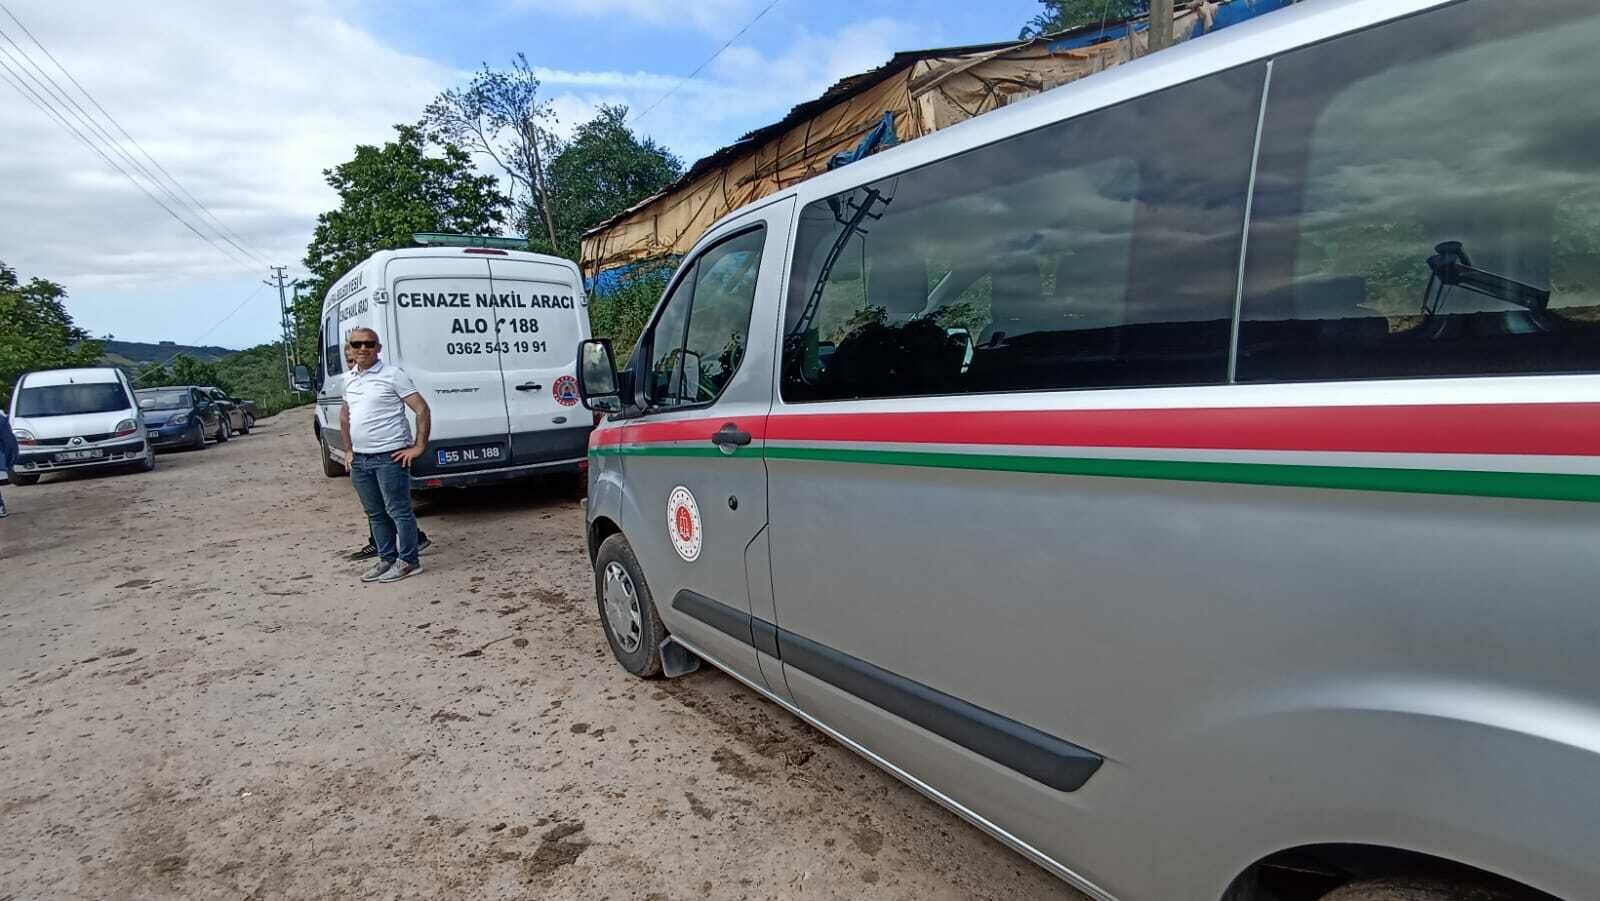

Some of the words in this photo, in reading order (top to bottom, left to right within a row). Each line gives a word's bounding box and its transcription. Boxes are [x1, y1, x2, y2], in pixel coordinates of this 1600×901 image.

[397, 293, 471, 308] CENAZE
[476, 291, 527, 308] NAKİL
[531, 295, 575, 309] ARACI
[451, 318, 488, 334] ALO
[509, 318, 539, 333] 188
[447, 342, 482, 355] 0362
[485, 341, 510, 354] 543
[514, 341, 529, 353] 19
[532, 341, 547, 353] 91
[446, 451, 460, 462] 55
[463, 449, 479, 461] NL
[481, 447, 500, 458] 188
